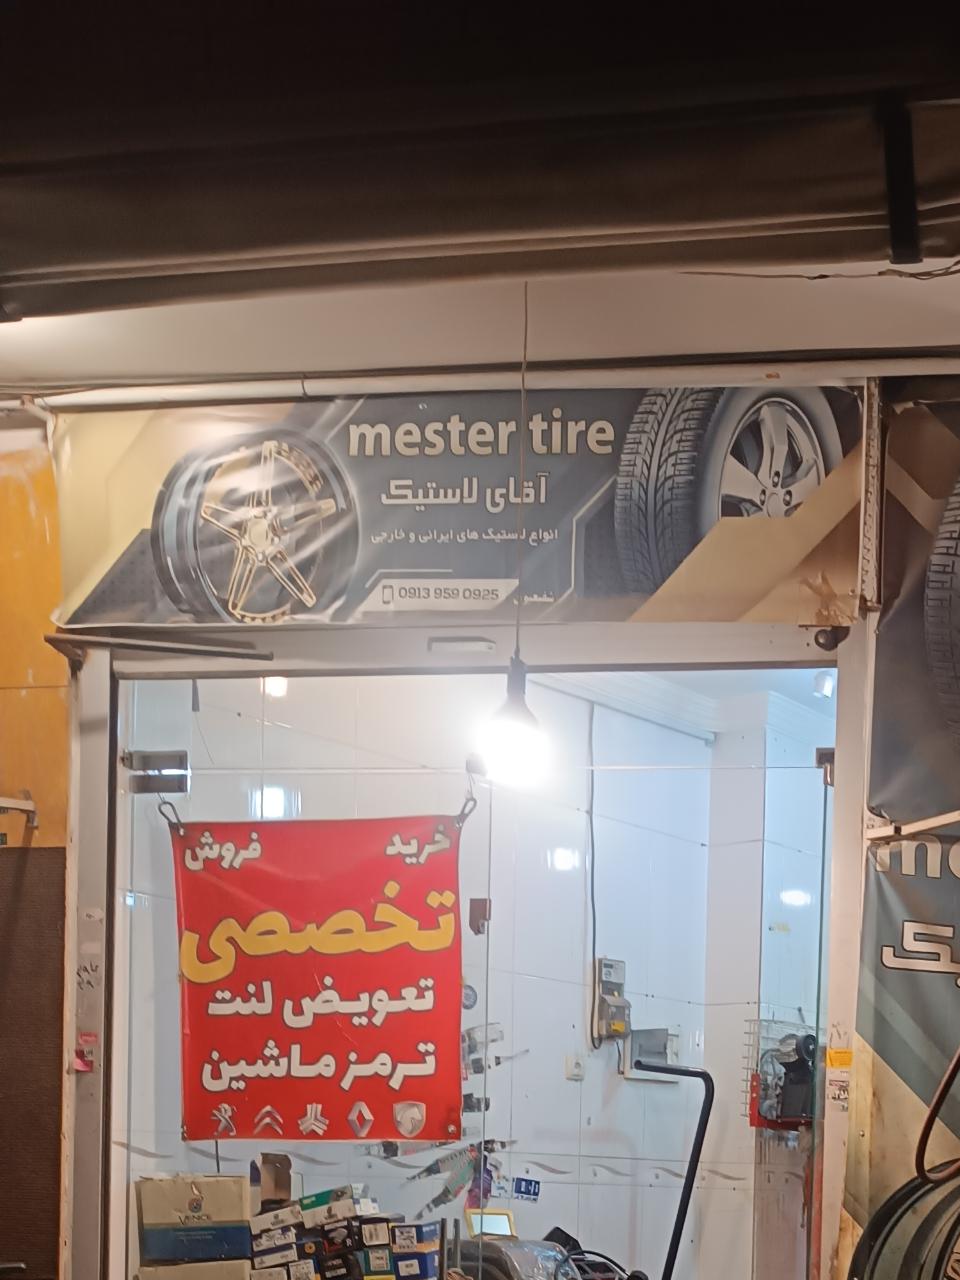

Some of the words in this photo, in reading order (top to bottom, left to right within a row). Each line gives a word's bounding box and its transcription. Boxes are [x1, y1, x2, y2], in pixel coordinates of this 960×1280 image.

[348, 413, 517, 457] mester
[528, 407, 615, 455] tire
[380, 477, 479, 511] لاستیک
[485, 472, 549, 513] آقای
[370, 528, 405, 543] خارجی
[408, 532, 416, 543] و
[418, 528, 453, 543] ایرانی
[456, 527, 479, 543] های
[529, 528, 558, 545] انواع
[398, 586, 430, 600] 0913
[434, 585, 460, 600] 959
[462, 587, 499, 601] 0925
[184, 831, 262, 870] فروش
[385, 824, 451, 864] خرید
[180, 880, 456, 984] تخصصی
[208, 980, 273, 1015] لنت
[283, 976, 434, 1028] تعویض
[202, 1039, 336, 1091] ماشین
[340, 1042, 436, 1091] ترمز
